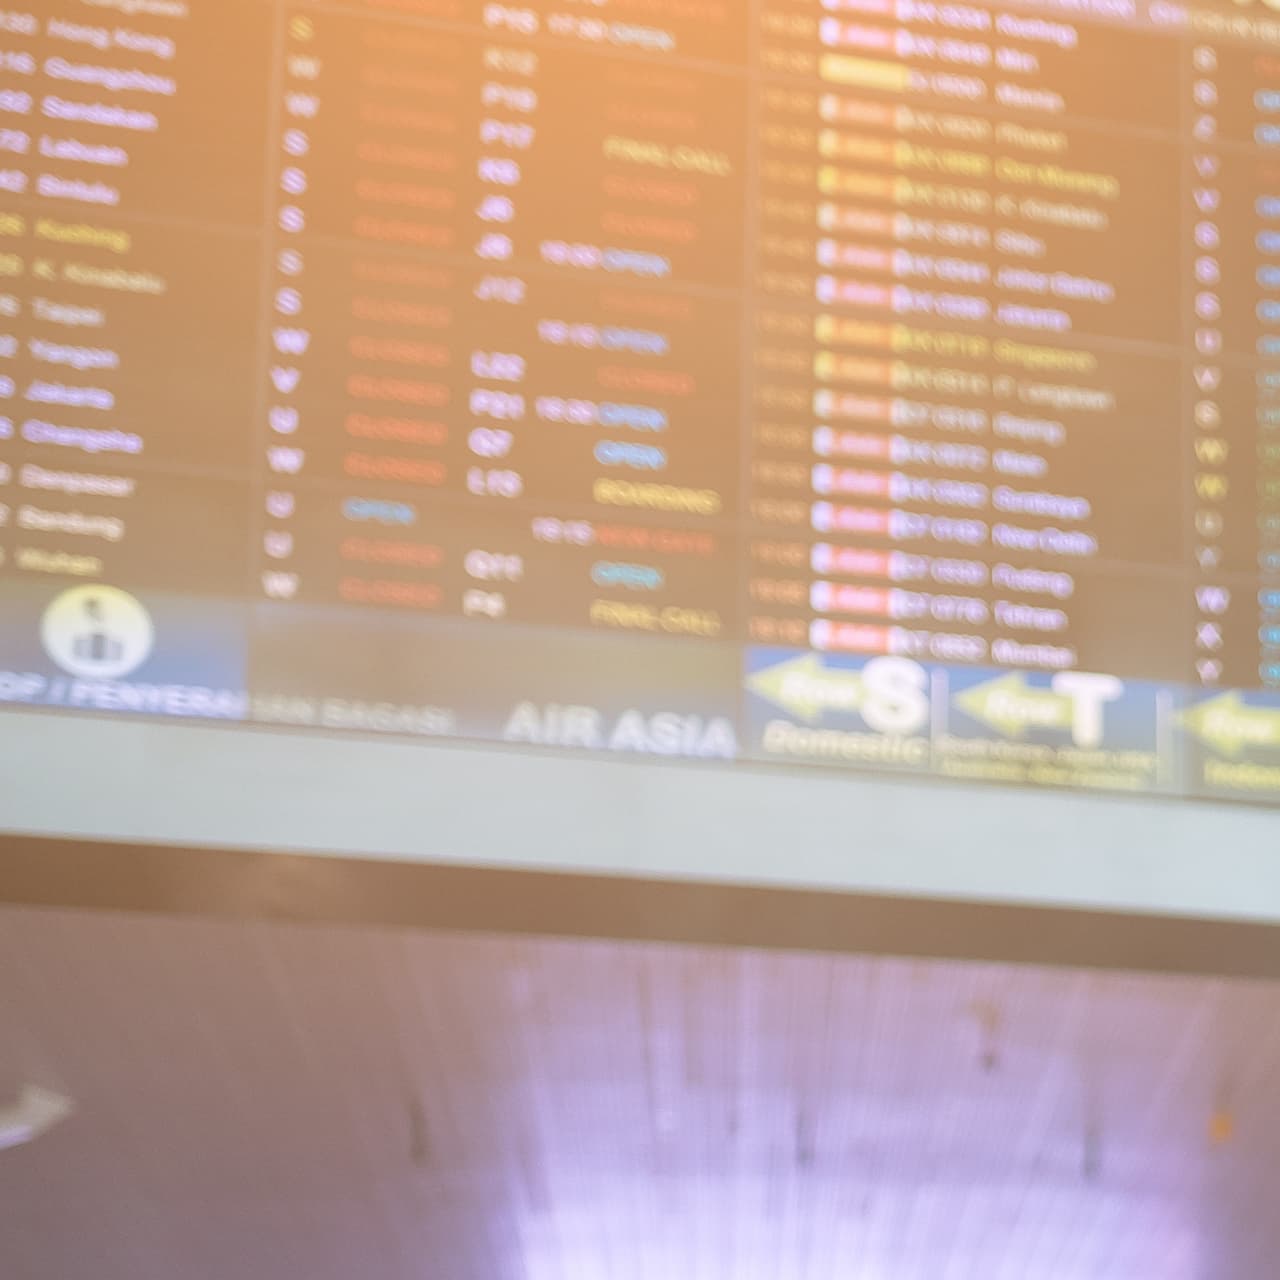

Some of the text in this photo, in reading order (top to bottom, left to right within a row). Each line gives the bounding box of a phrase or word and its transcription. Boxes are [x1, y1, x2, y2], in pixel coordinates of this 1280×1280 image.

[504, 699, 738, 760] AIR ASIA
[860, 656, 931, 735] S
[1051, 669, 1125, 748] T
